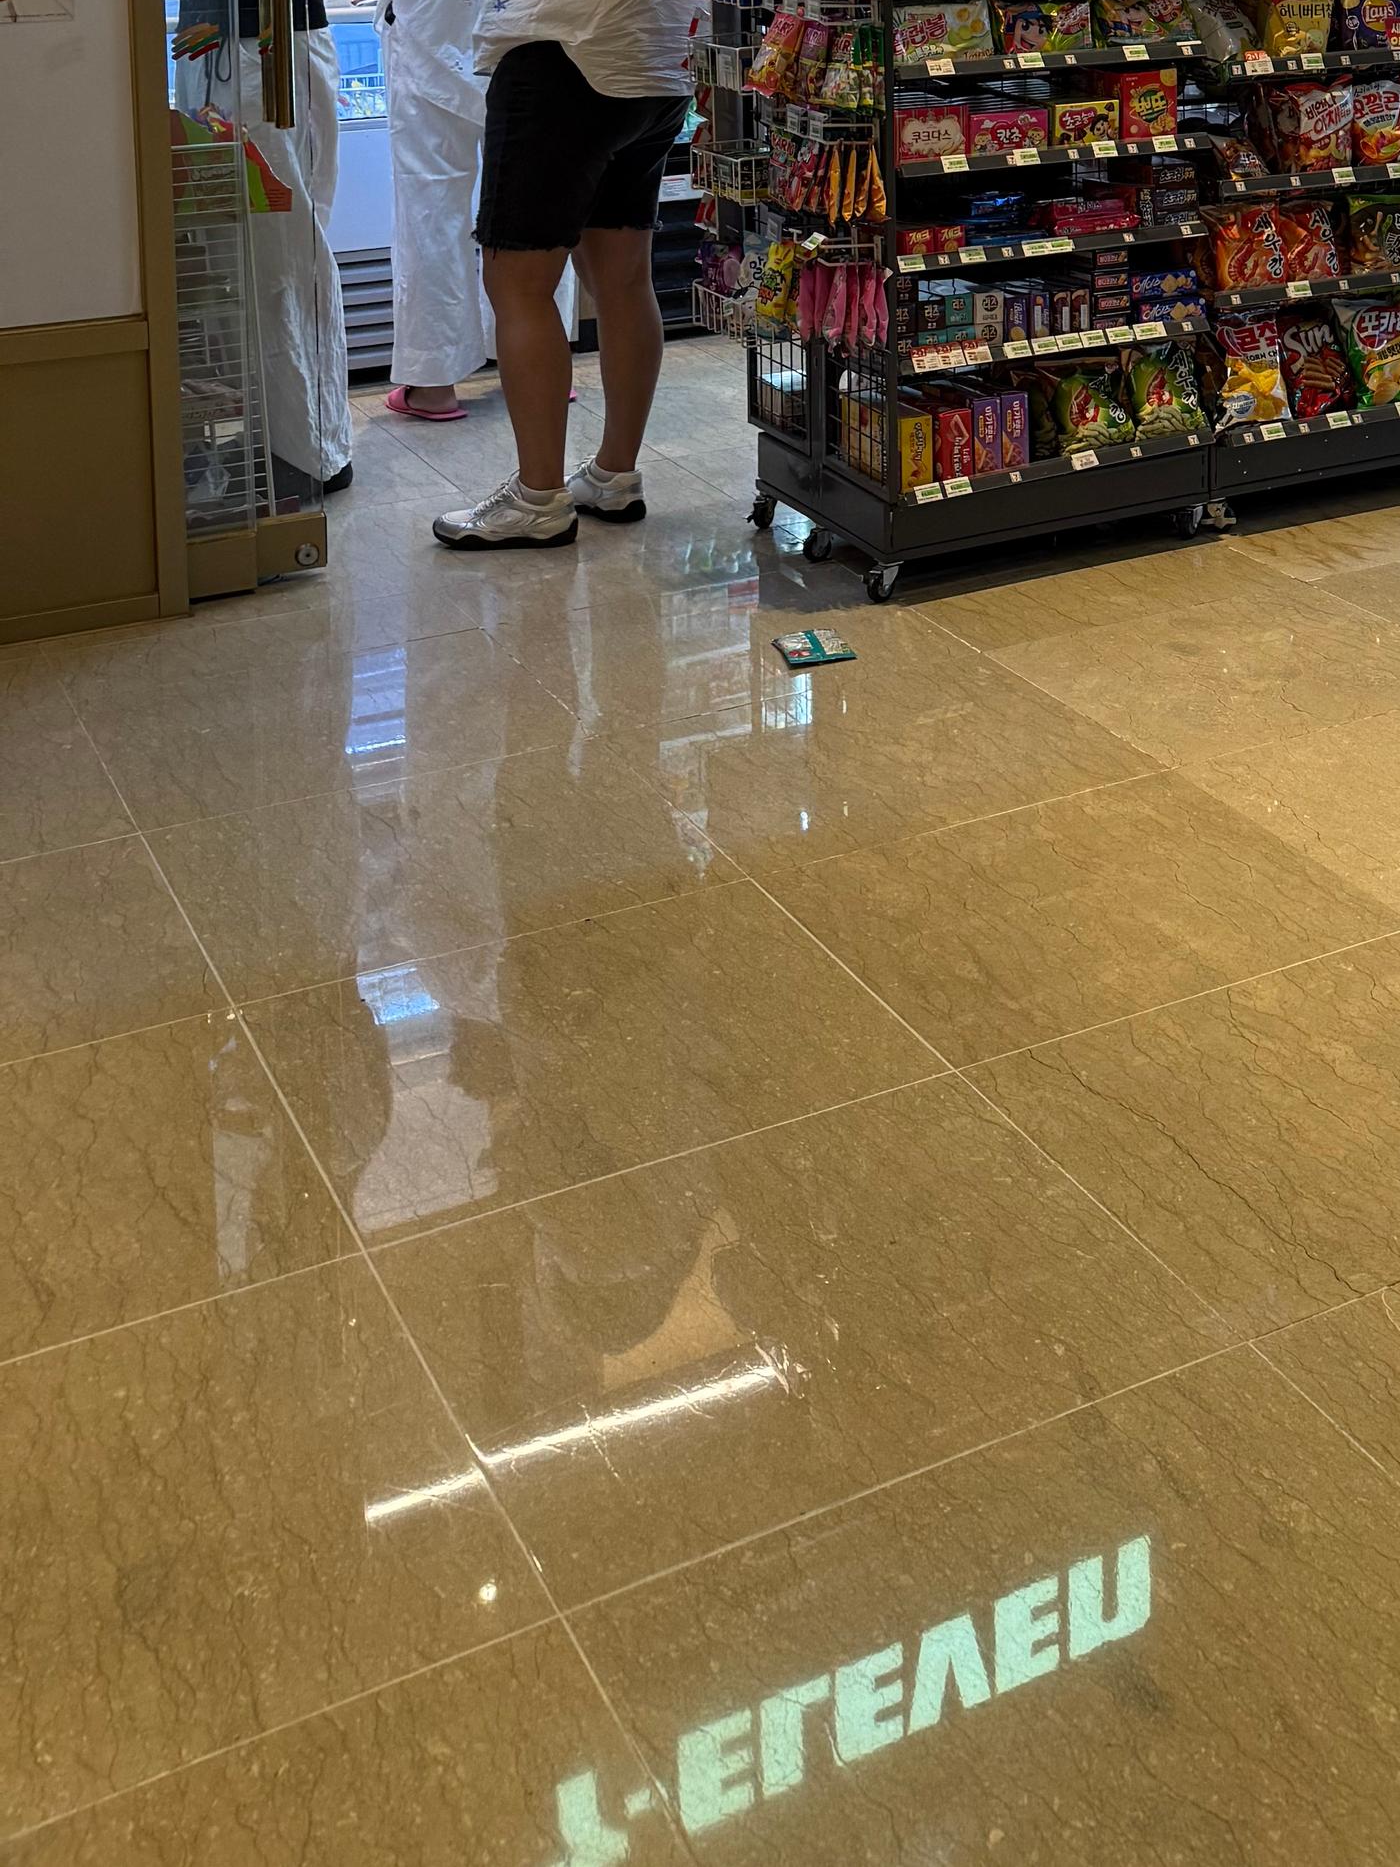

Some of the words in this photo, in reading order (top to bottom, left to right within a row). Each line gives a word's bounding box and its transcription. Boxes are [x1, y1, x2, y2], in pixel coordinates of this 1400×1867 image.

[1365, 4, 1395, 23] Lay's
[911, 130, 952, 145] 쿠크다스
[995, 127, 1023, 142] 칸쵸
[1252, 211, 1285, 278] 새우깡
